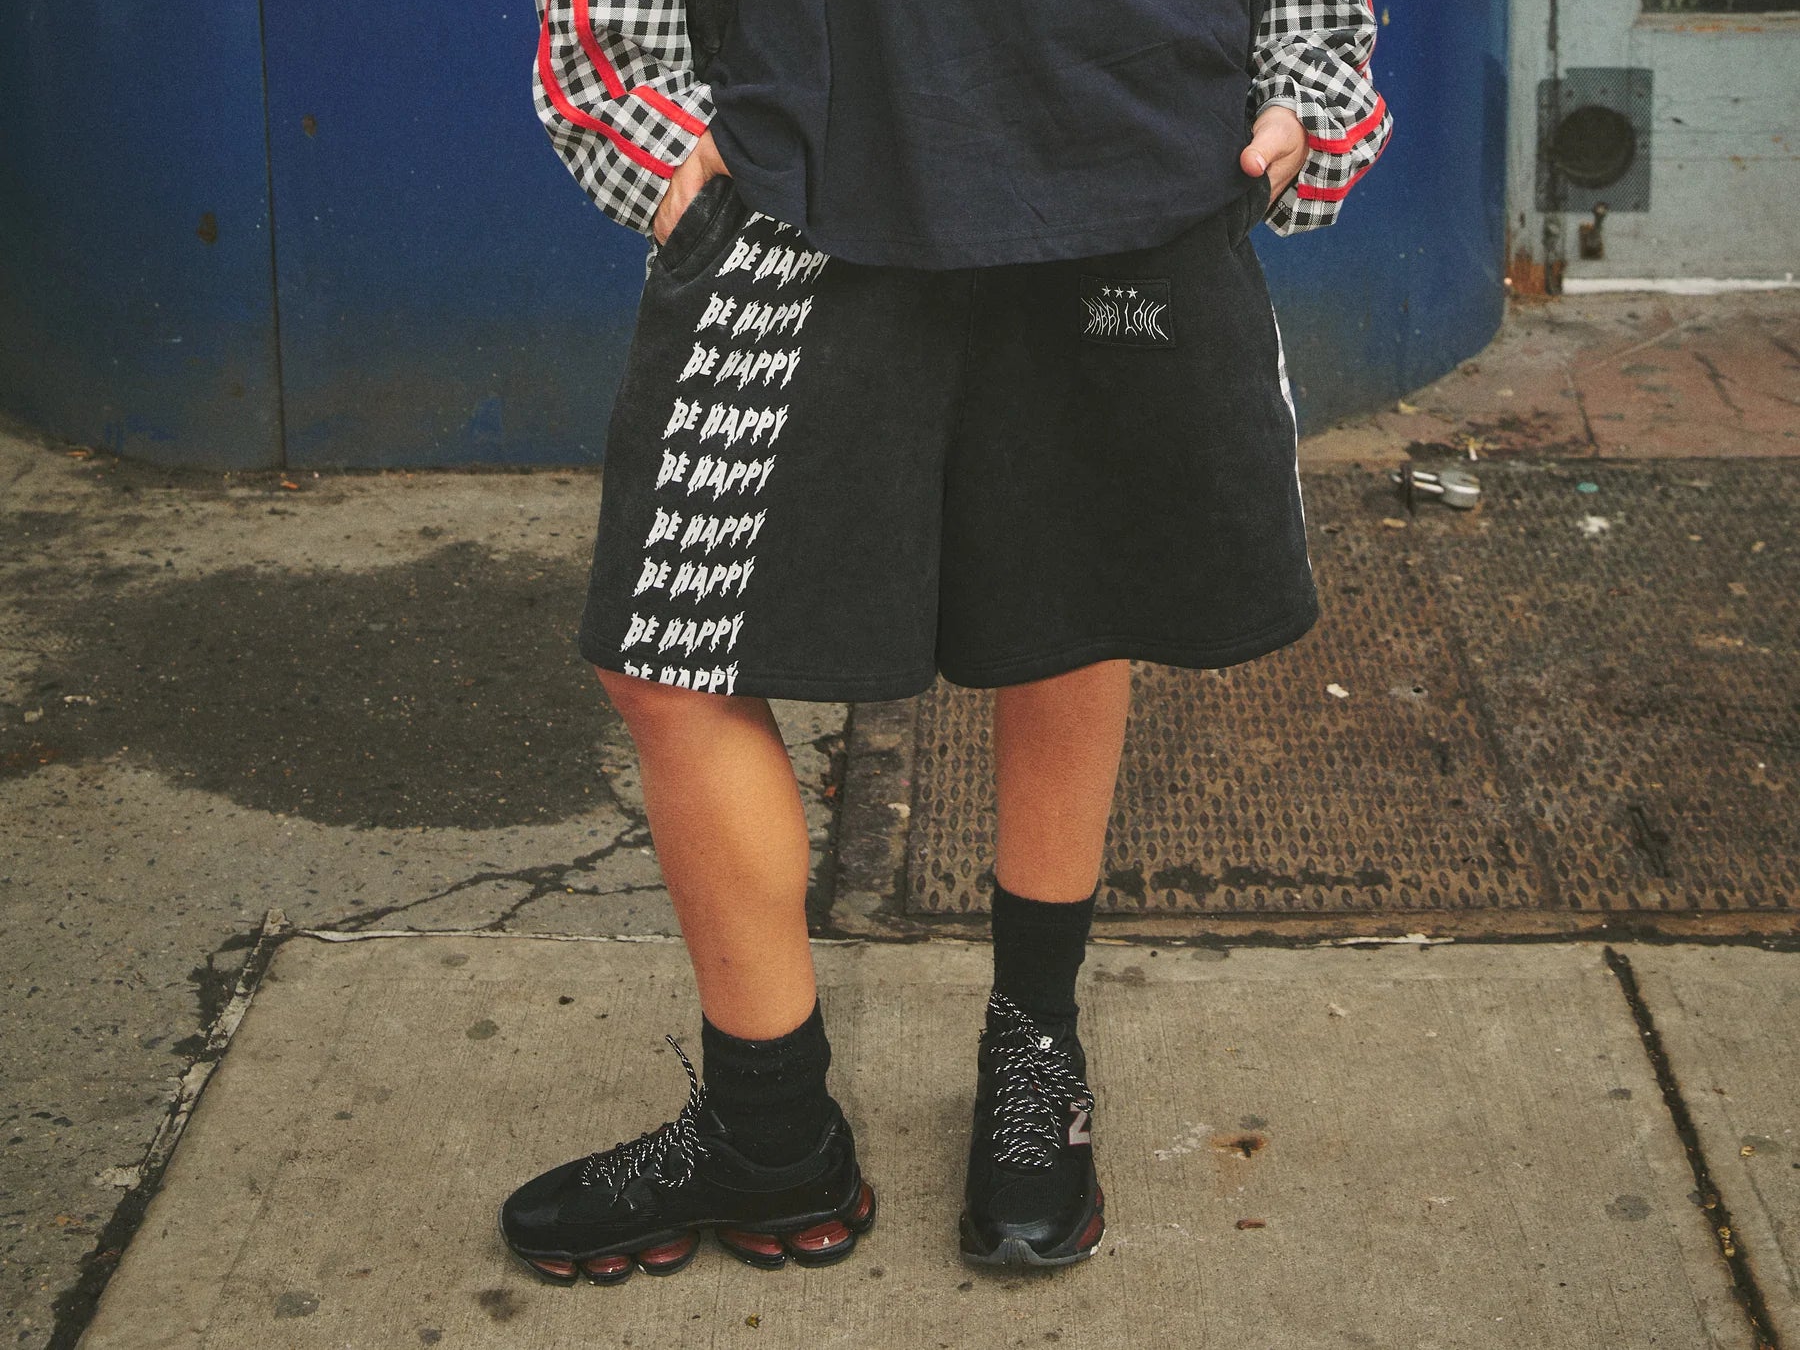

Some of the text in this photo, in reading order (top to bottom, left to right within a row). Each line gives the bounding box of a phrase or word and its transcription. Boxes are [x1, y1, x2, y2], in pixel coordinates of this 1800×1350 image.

[715, 235, 830, 290] BE HAPPY
[694, 291, 814, 344] BE HAPPY
[676, 340, 802, 391] BE HAPPY
[661, 396, 790, 450] BE HAPPY
[654, 447, 777, 502] BE HAPPY
[642, 506, 768, 556] BE HAPPY
[632, 555, 756, 605] BE HAPPY
[619, 611, 745, 658] BE HAPPY
